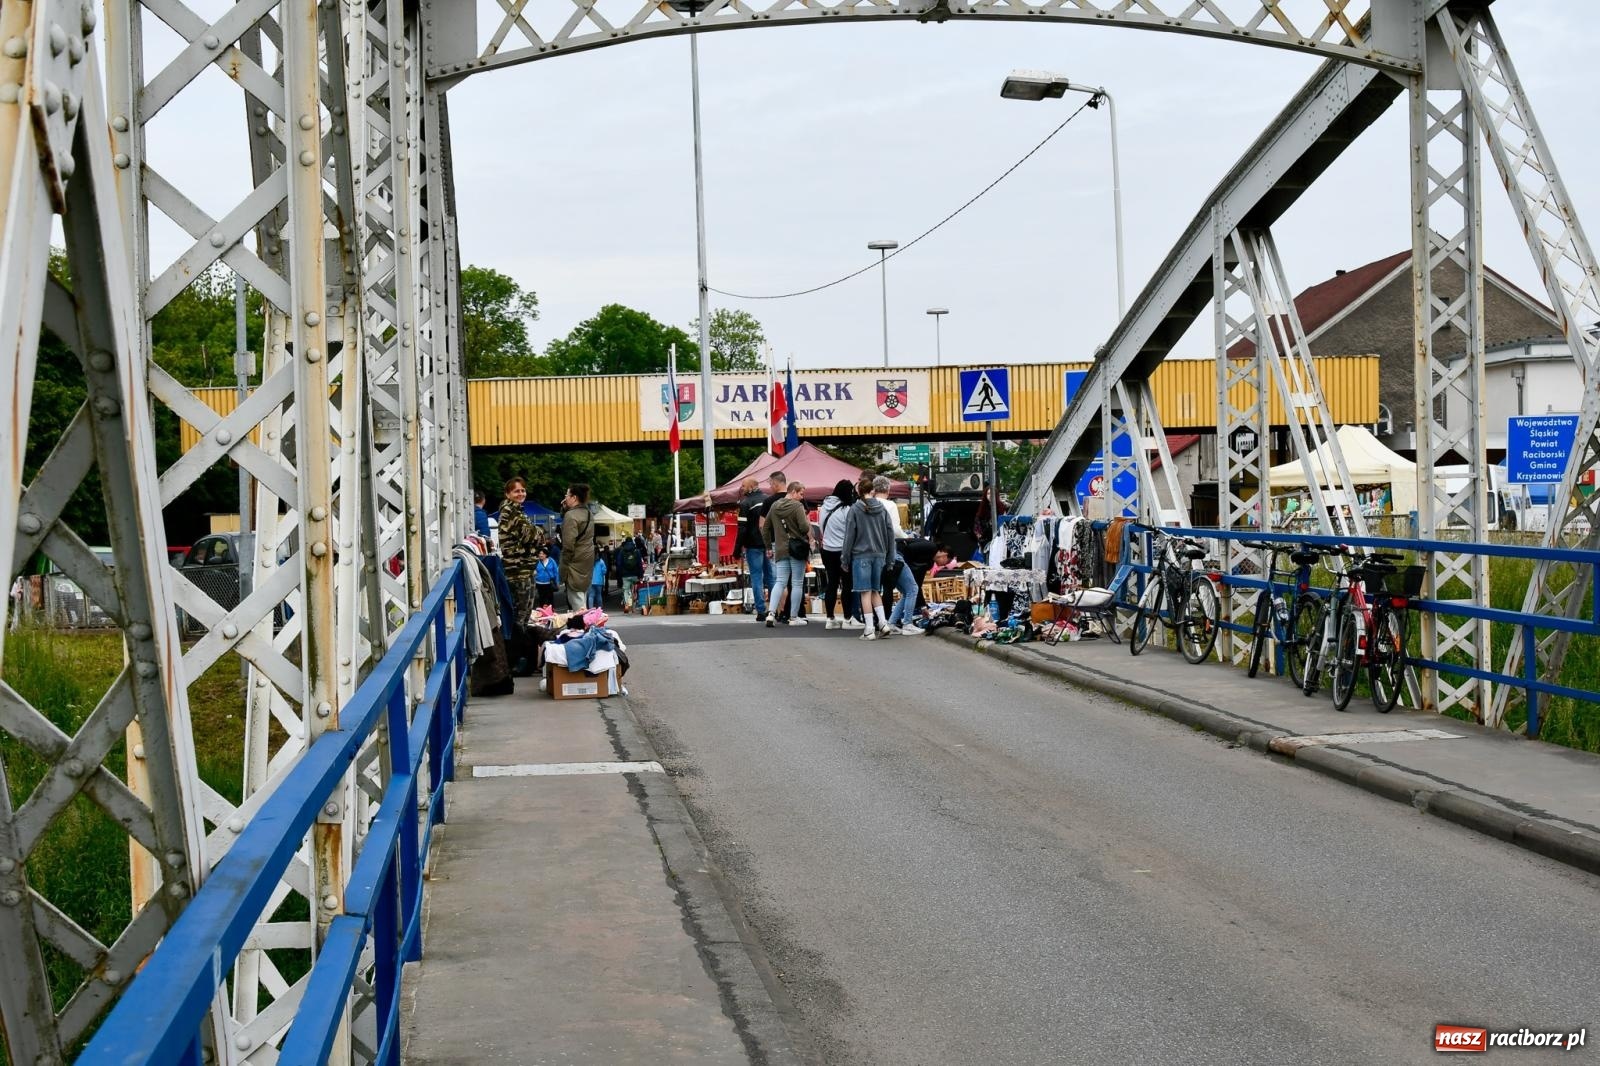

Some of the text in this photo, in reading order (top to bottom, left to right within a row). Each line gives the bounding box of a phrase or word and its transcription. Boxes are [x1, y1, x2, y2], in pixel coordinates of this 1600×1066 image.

[730, 408, 836, 422] NA NICY
[1516, 418, 1573, 428] Województwo
[1529, 427, 1559, 439] Śląskie
[1530, 440, 1558, 448] Powiat
[1522, 450, 1565, 459] Raciborski
[1530, 460, 1557, 469] Gmina
[1516, 471, 1565, 481] Krzyżanowic
